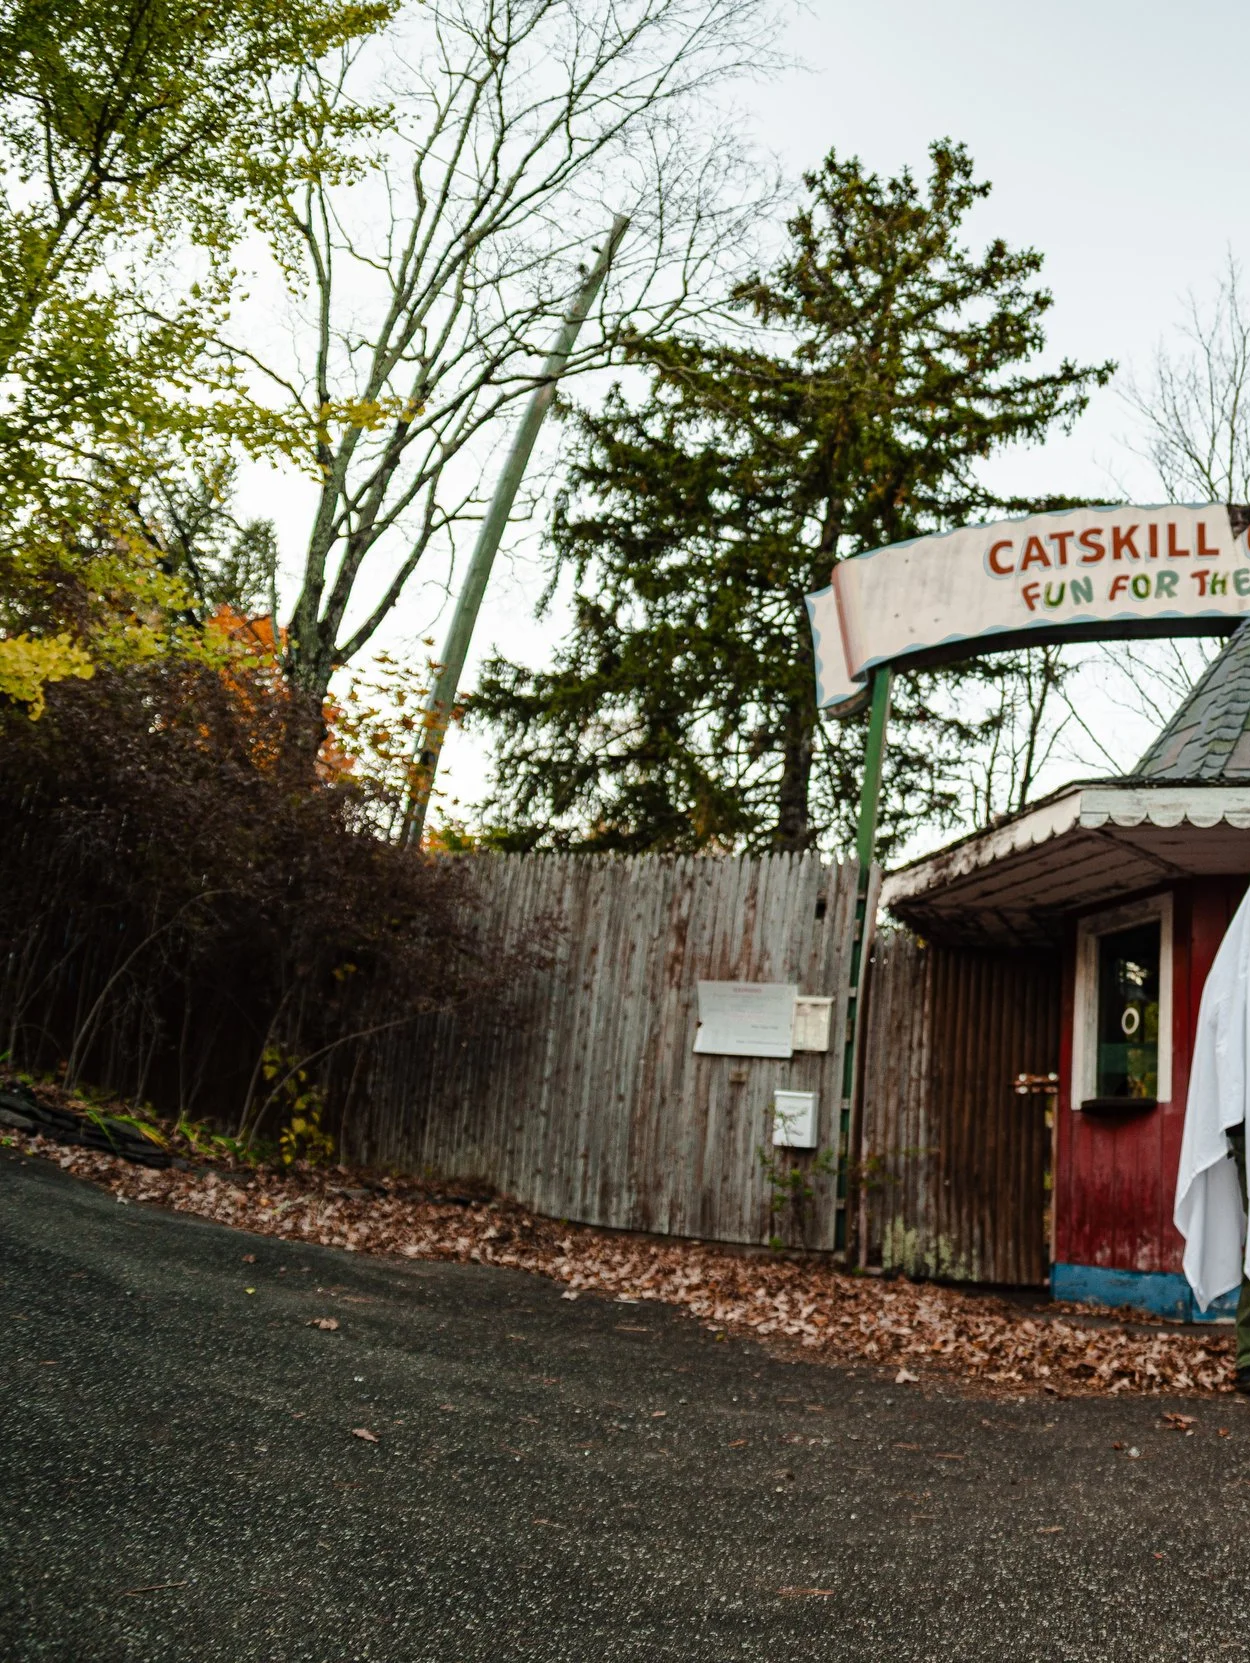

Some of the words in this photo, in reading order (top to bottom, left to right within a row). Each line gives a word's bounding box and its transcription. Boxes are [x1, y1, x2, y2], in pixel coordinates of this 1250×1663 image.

[988, 522, 1220, 575] CATSKILL
[1021, 575, 1094, 611] FUN
[1109, 569, 1180, 601] FOR
